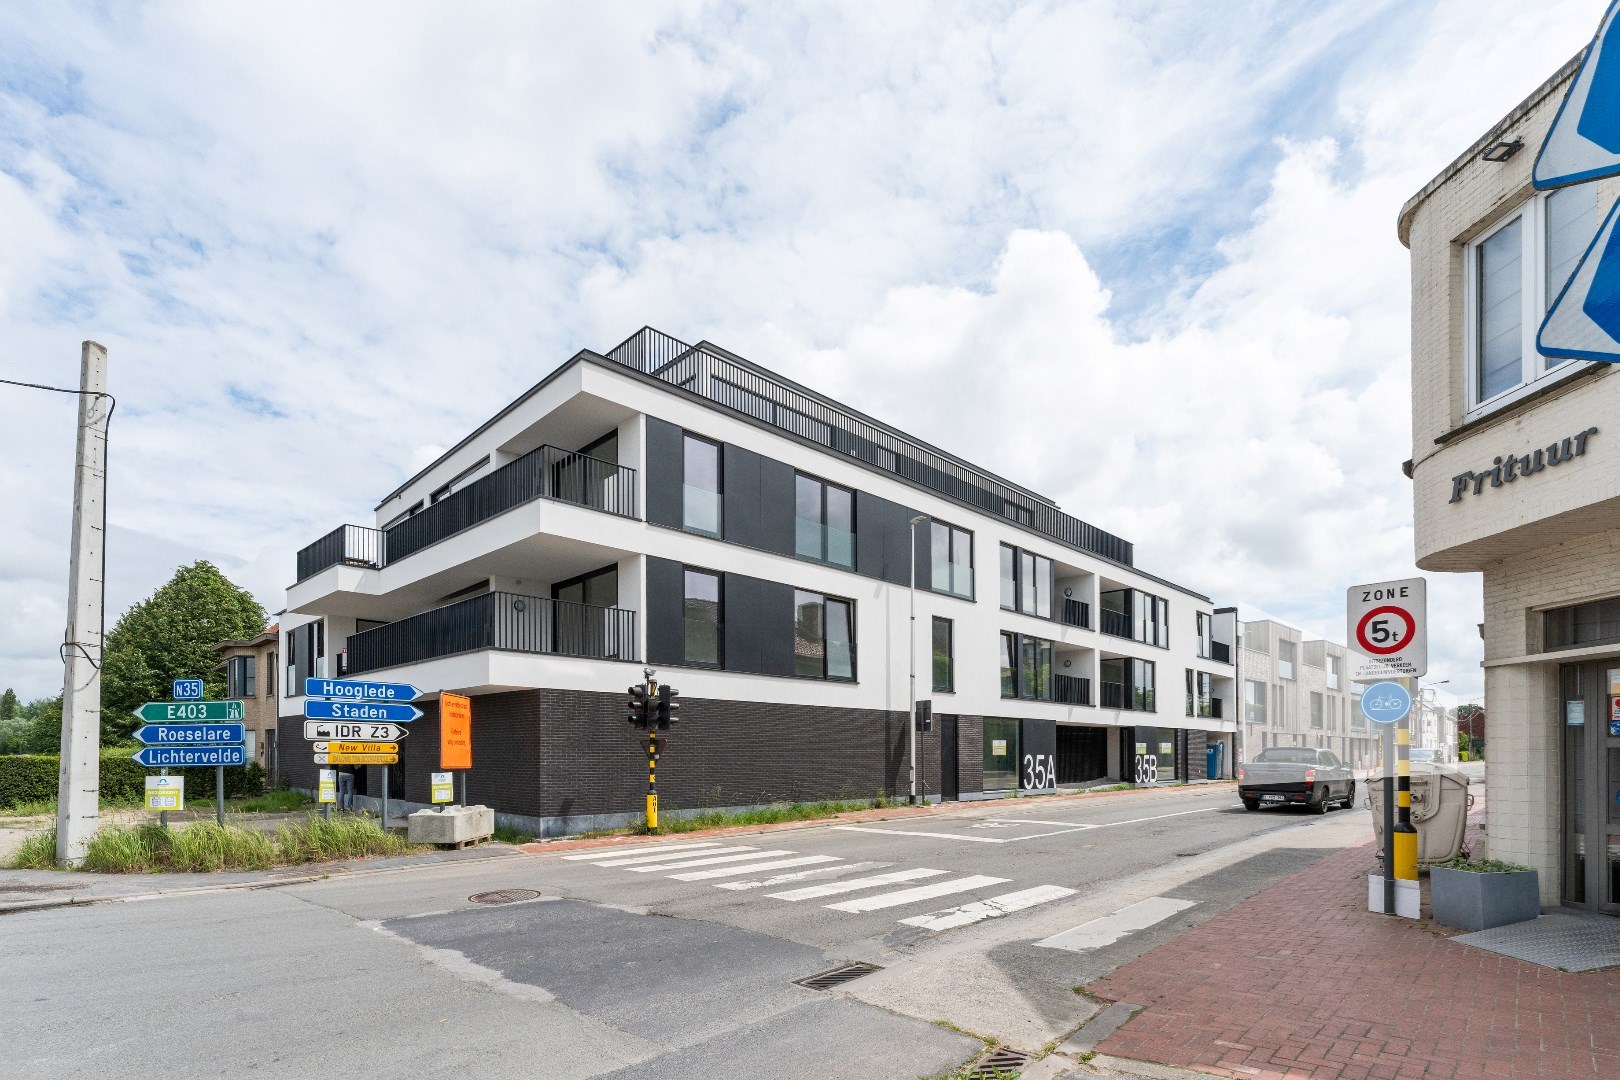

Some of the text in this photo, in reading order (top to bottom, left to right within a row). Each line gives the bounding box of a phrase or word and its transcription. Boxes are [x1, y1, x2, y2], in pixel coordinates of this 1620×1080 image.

[1449, 427, 1597, 504] Frituur
[1362, 587, 1409, 602] ZONE
[176, 682, 198, 696] N35
[323, 681, 395, 700] Hooglede
[167, 704, 207, 719] E403
[331, 703, 387, 719] Staden
[158, 727, 231, 741] Roeselare
[335, 724, 390, 739] IDR Z3
[338, 743, 381, 752] New Villa
[149, 749, 240, 764] Lichtervelde
[1023, 754, 1057, 790] 35A
[1135, 754, 1158, 784] 35B
